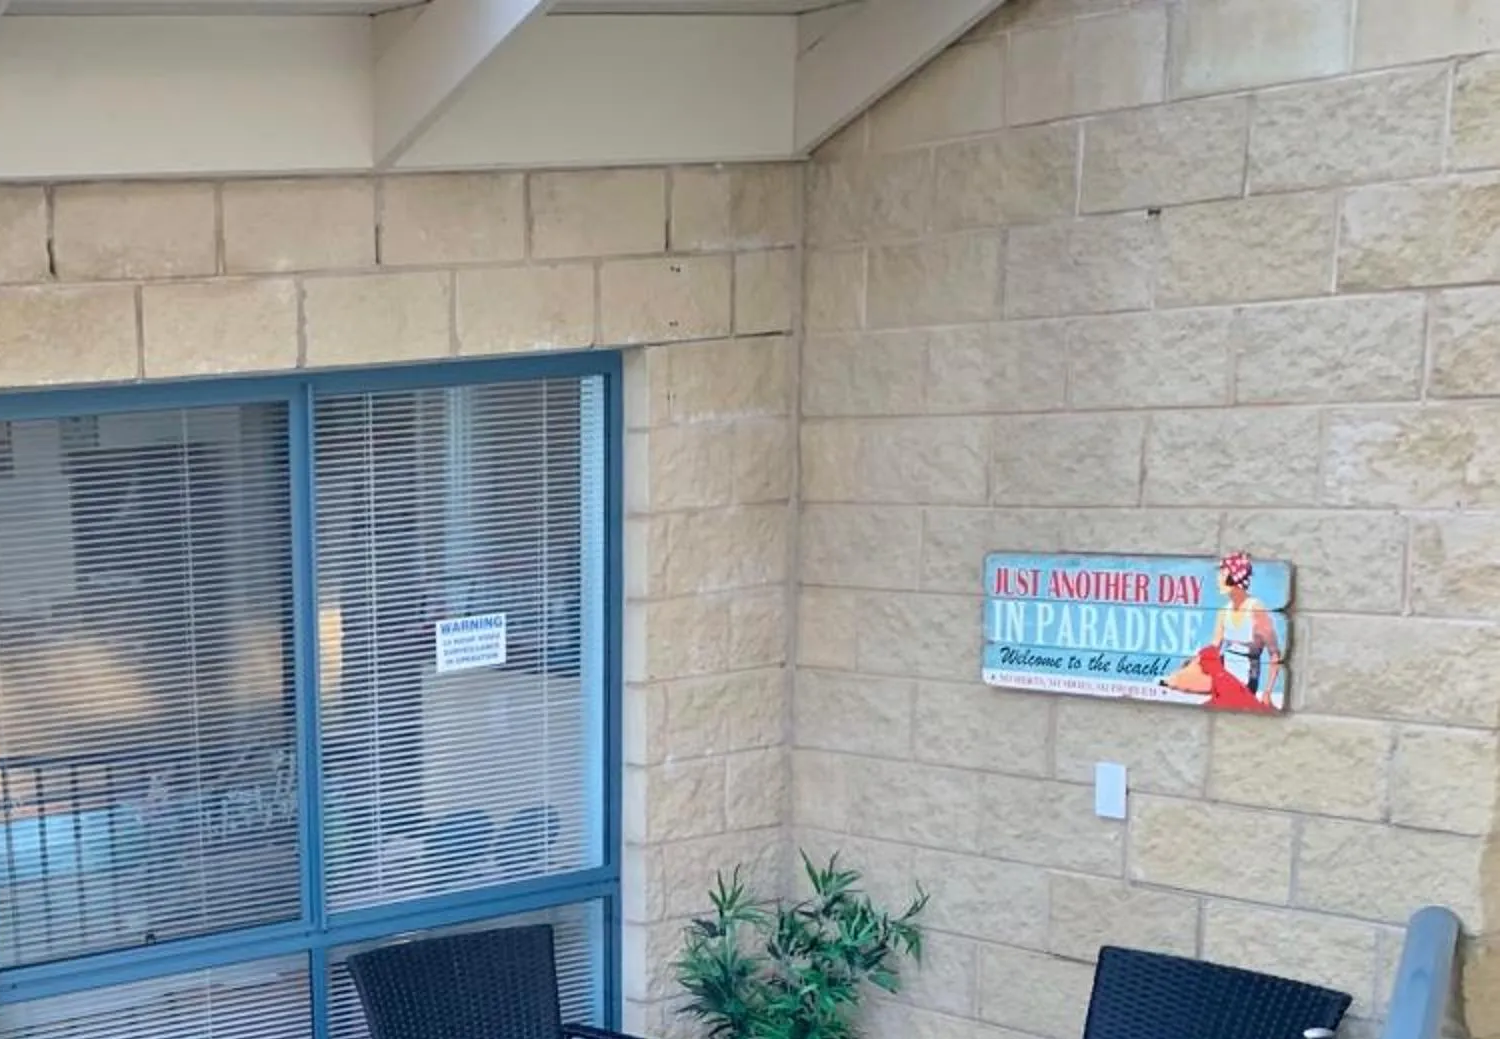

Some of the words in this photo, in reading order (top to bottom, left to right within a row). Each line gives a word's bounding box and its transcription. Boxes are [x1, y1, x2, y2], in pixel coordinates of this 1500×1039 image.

[995, 568, 1041, 597] JUST
[1049, 569, 1150, 603] ANOTHER
[1157, 574, 1204, 605] DAY
[440, 616, 503, 634] WARNING
[992, 600, 1026, 643] IN
[1035, 602, 1204, 654] PARADISE
[1000, 646, 1064, 669] Welcome
[1068, 656, 1082, 670] to
[1088, 652, 1112, 673] the
[1116, 655, 1171, 677] beach!
